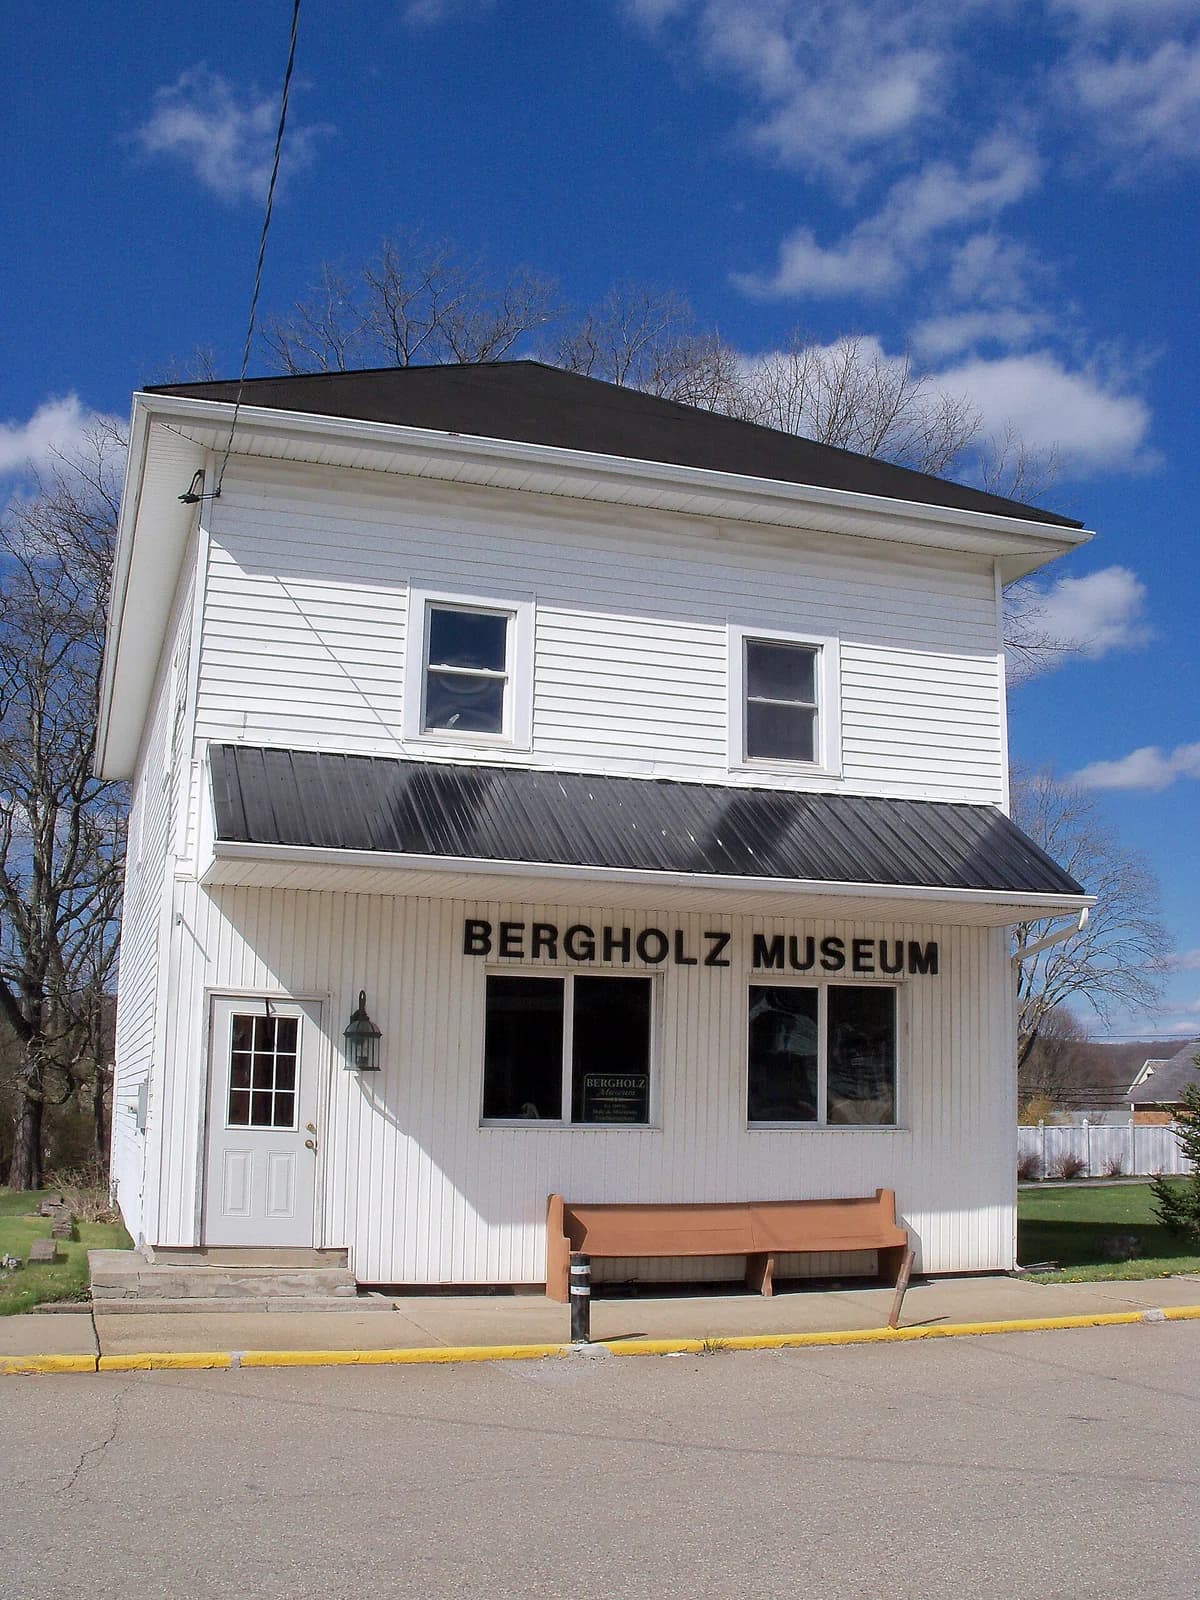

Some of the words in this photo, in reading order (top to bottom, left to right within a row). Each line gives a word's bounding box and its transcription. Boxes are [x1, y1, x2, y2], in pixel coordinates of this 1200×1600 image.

[463, 919, 731, 967] BERGHOLZ
[752, 933, 938, 975] MUSEUM
[586, 1078, 646, 1089] BERGHOLZ
